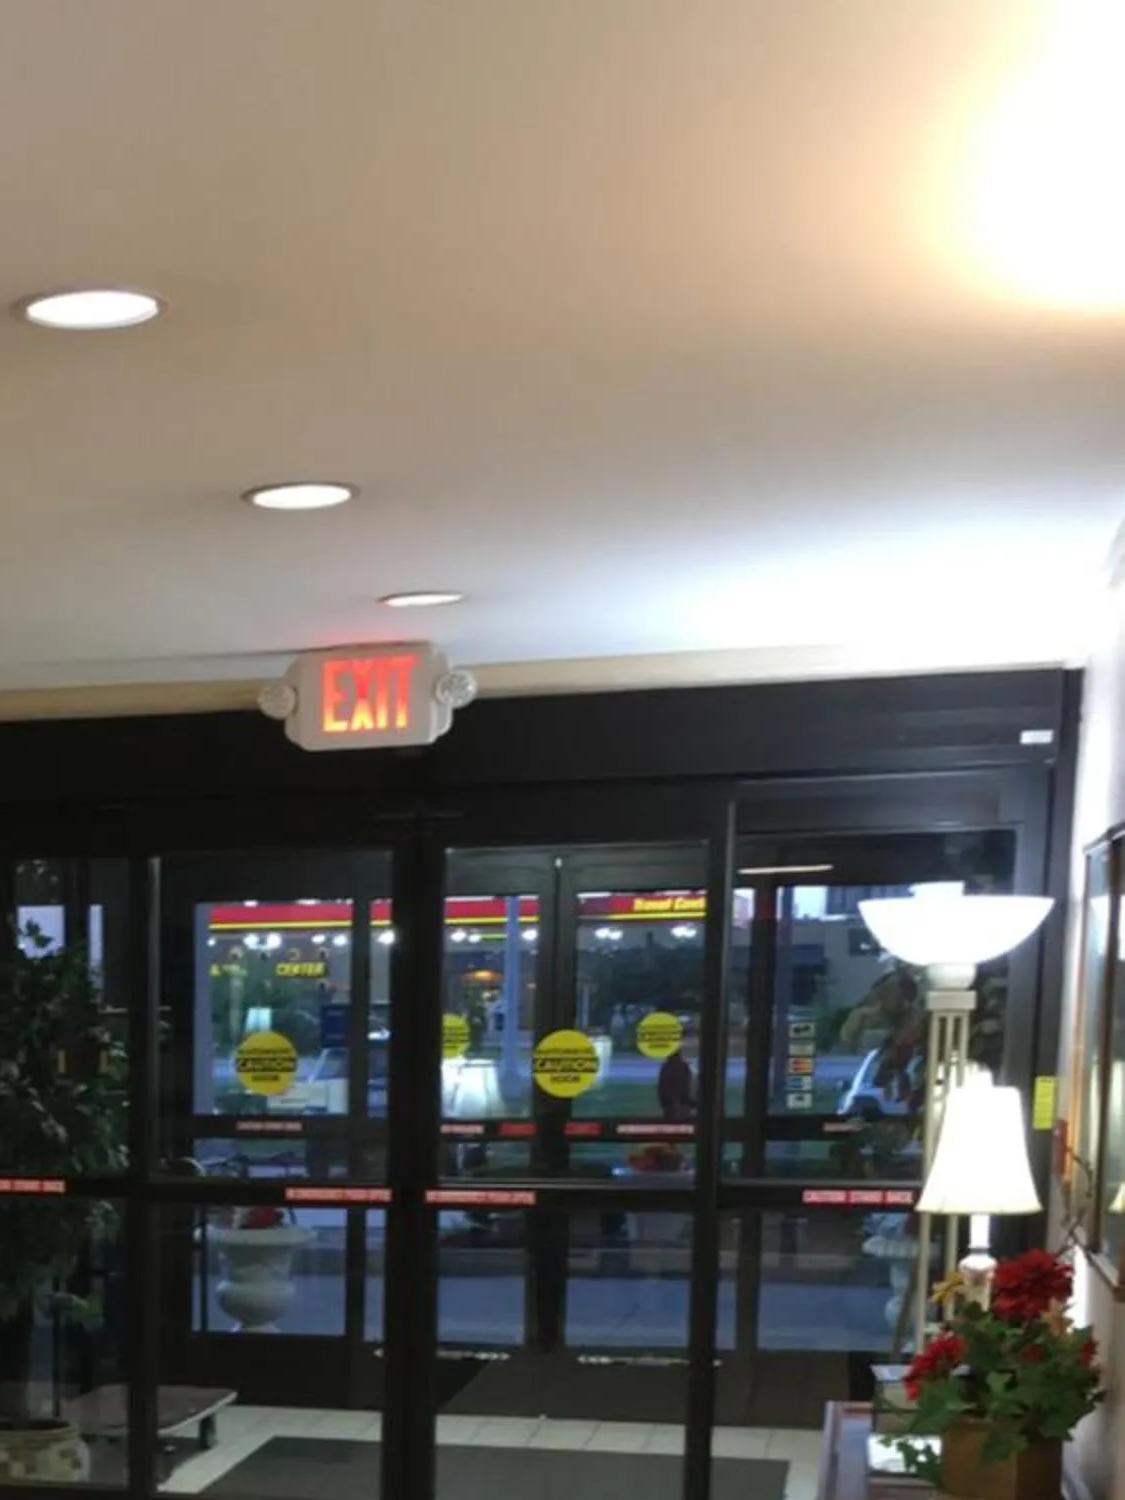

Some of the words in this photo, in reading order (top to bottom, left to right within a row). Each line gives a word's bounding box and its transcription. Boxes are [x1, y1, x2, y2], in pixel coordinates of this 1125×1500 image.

[323, 658, 417, 732] EXIT
[238, 1058, 294, 1072] CAUTION
[535, 1058, 597, 1071] CAUTION
